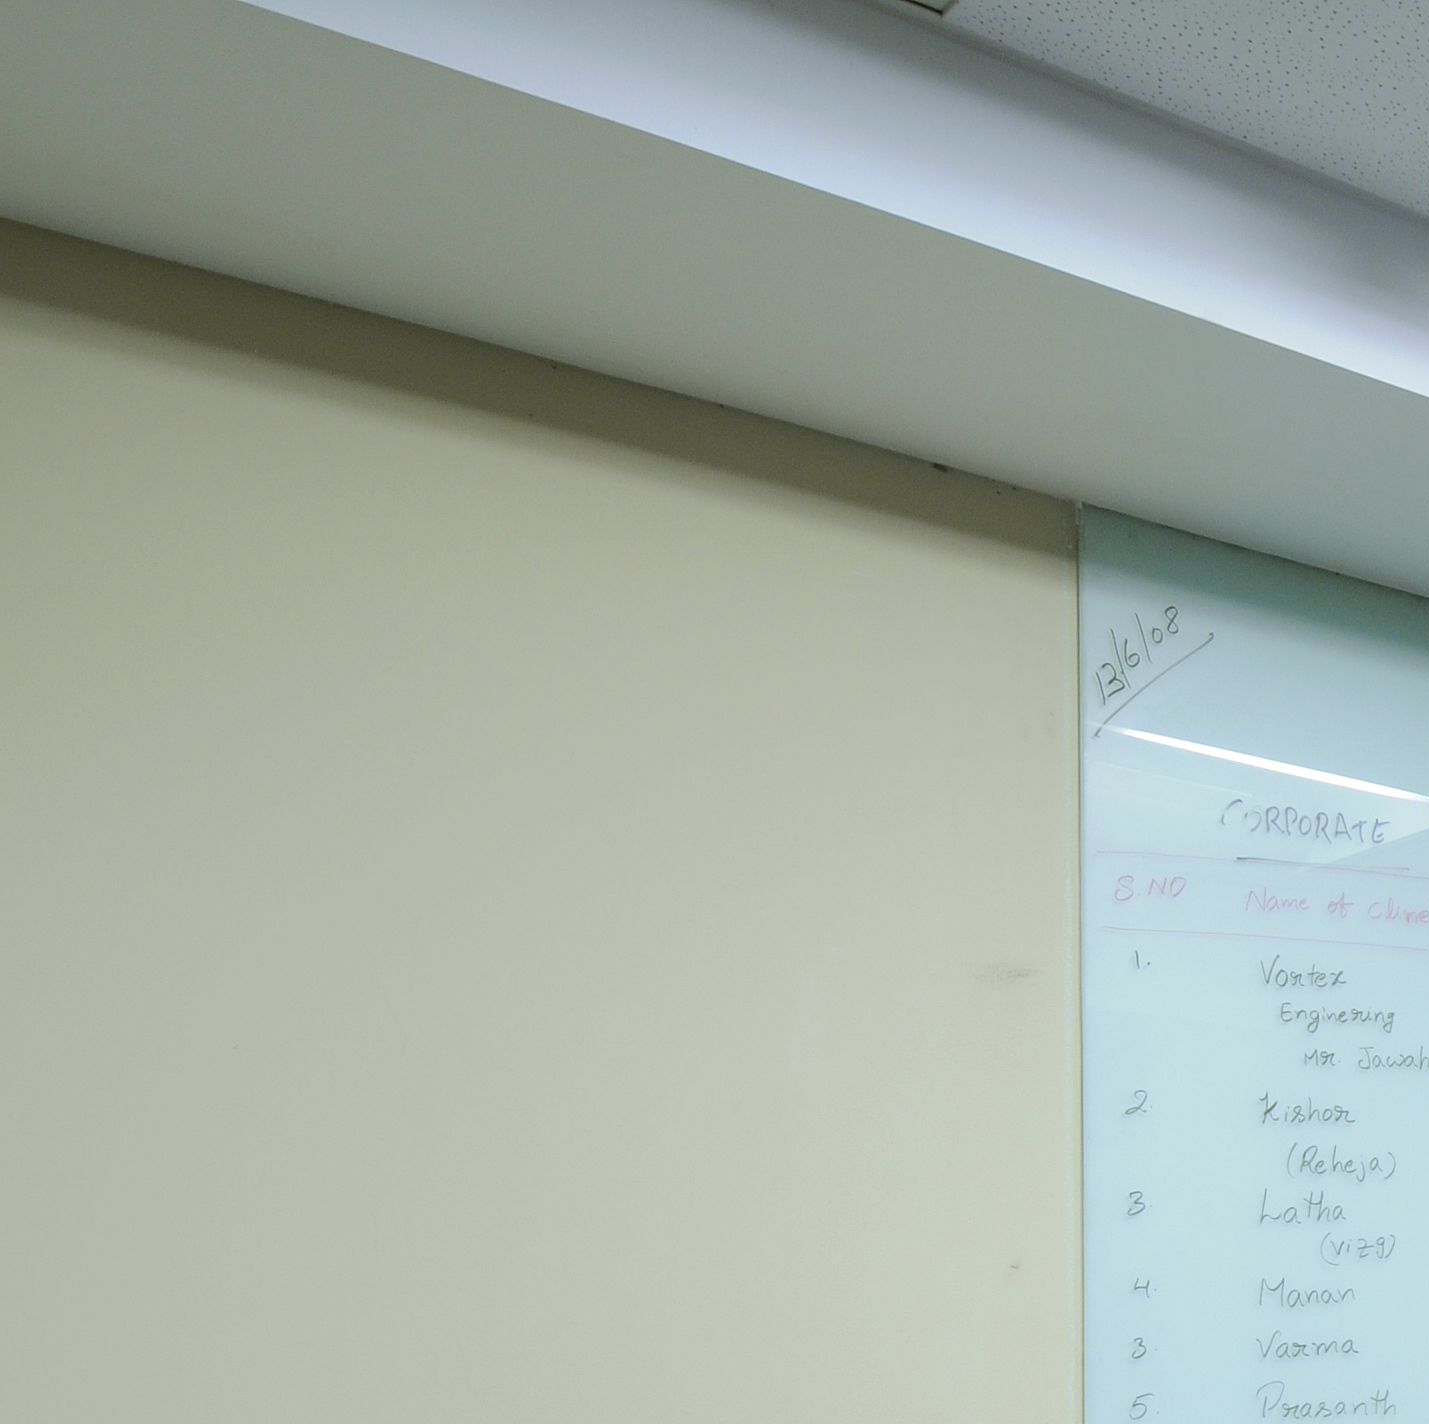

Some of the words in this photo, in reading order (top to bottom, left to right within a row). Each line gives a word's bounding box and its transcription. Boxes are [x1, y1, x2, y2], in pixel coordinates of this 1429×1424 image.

[1245, 888, 1310, 913] Name
[1327, 890, 1354, 918] of
[1259, 953, 1348, 989] Vortex
[1258, 1187, 1347, 1225] Latha
[1258, 1276, 1356, 1309] Manan
[1255, 1329, 1360, 1360] Varma
[1255, 1380, 1397, 1421] Prasanth
